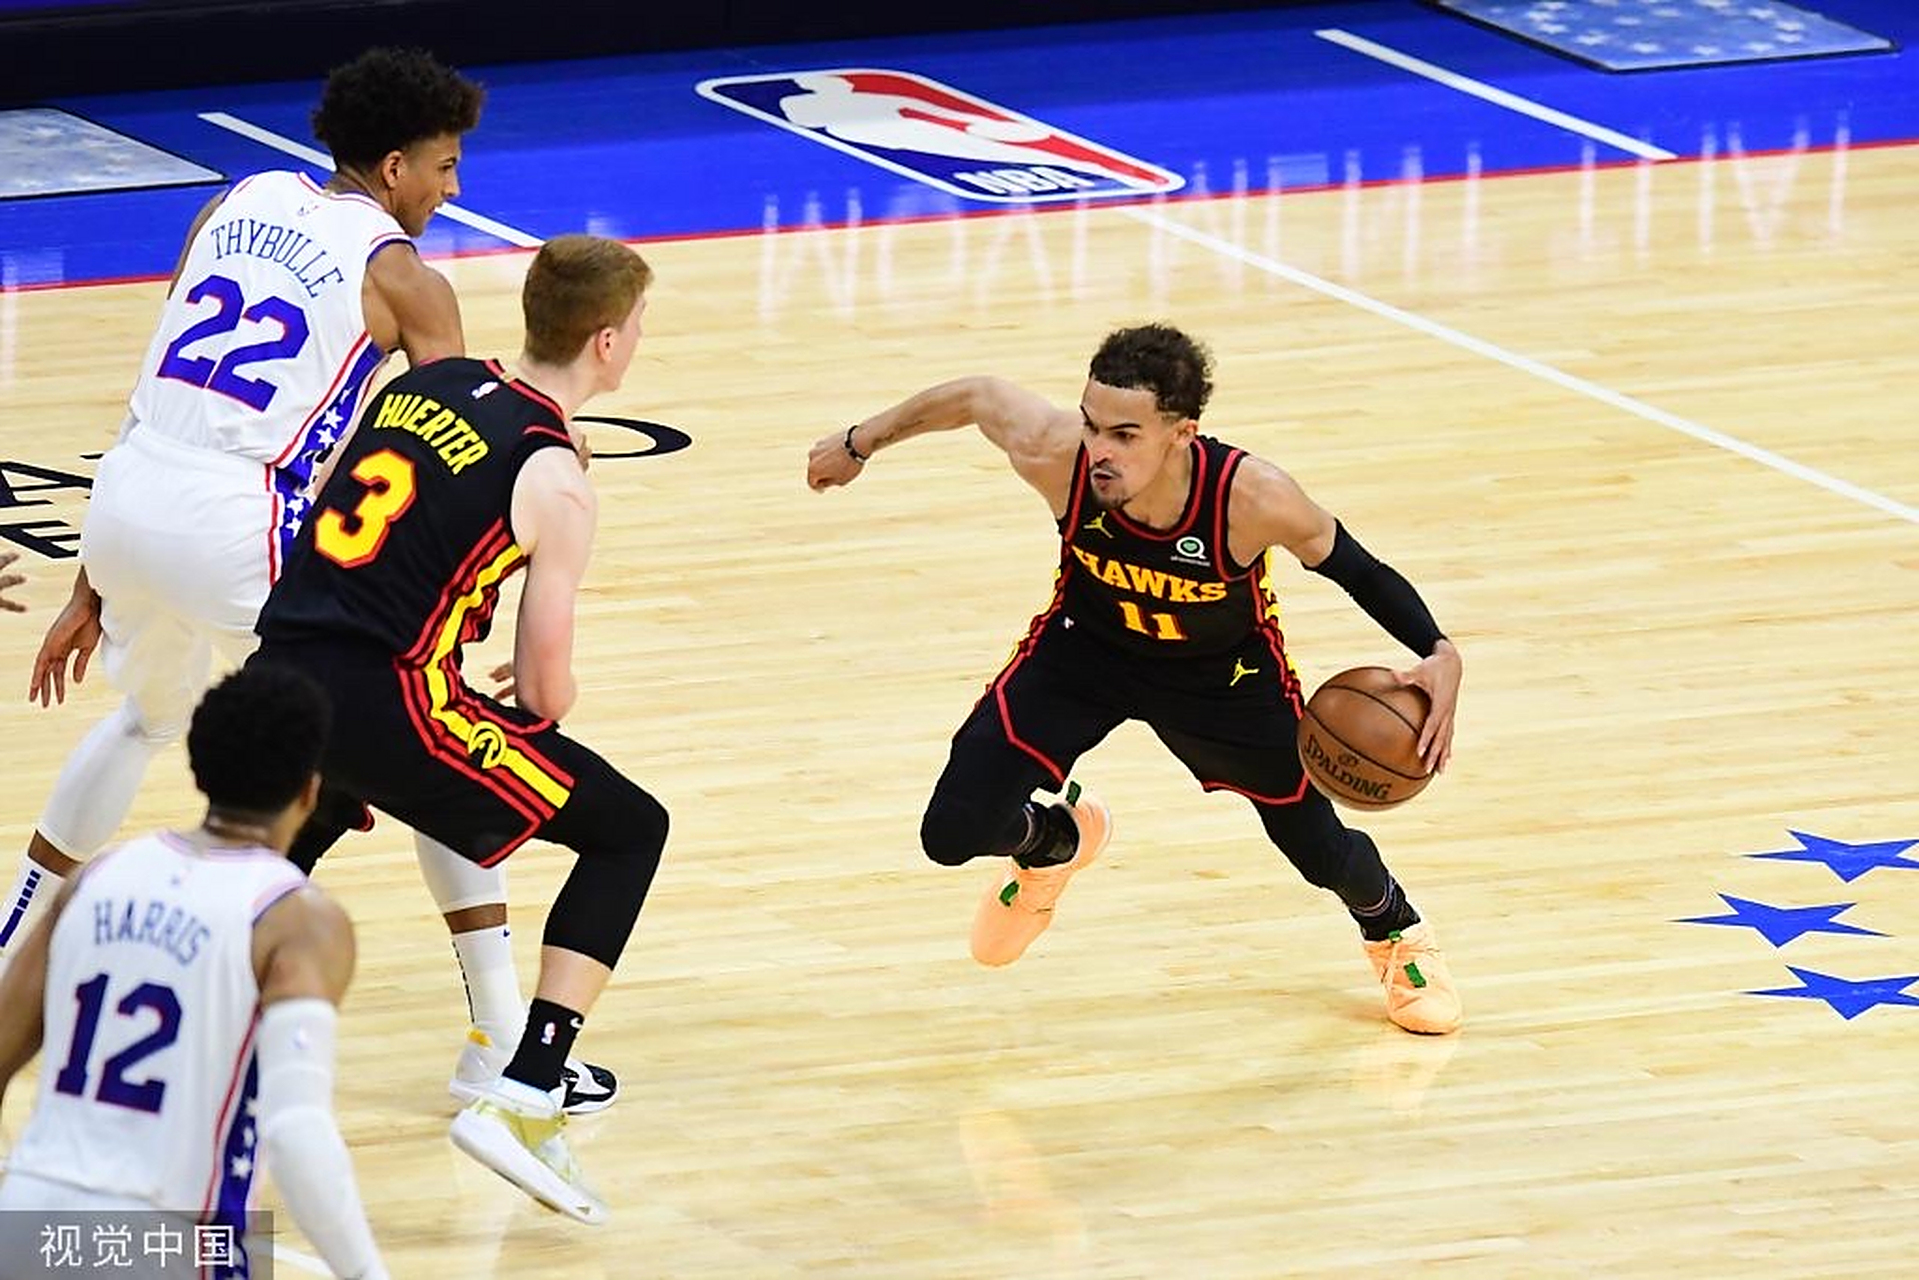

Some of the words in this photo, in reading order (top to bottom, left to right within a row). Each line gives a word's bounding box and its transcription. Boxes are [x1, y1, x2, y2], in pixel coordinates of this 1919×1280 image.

[953, 166, 1096, 195] NBA
[210, 218, 344, 298] THYBULLE
[156, 274, 310, 413] 22
[373, 394, 489, 475] HUERTER
[315, 448, 418, 569] 3
[1071, 545, 1227, 603] HAWKS
[1118, 601, 1189, 640] 11
[1304, 734, 1392, 799] SPALDING
[94, 899, 211, 966] HARRIS
[55, 973, 182, 1113] 12
